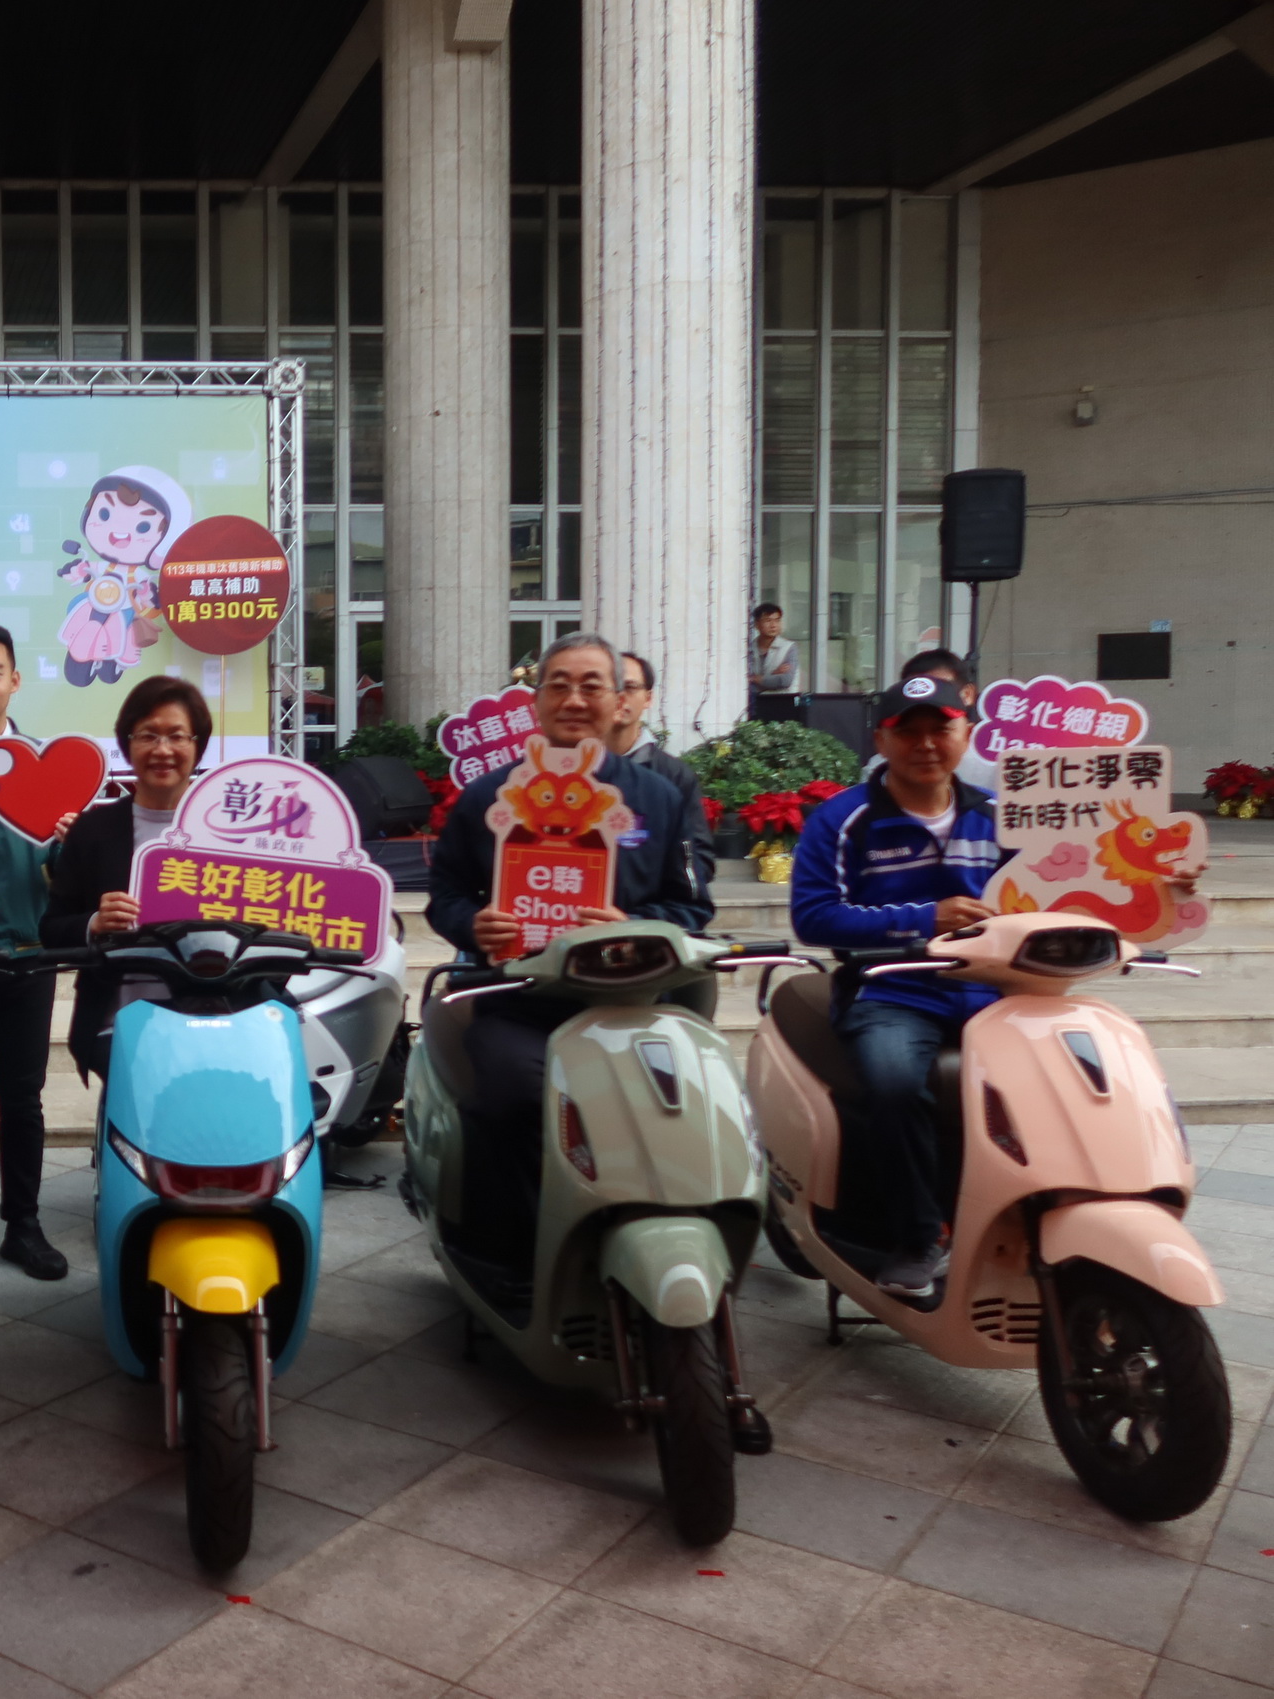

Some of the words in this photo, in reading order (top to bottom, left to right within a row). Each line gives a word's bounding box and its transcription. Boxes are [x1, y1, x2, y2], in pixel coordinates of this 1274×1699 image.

[165, 559, 284, 576] 113年機車汰舊換新補助
[189, 576, 260, 597] 最高補助
[166, 597, 279, 623] 1萬9300元
[451, 704, 542, 752] 汰車補
[994, 694, 1130, 741] 彰化鄉親
[1002, 750, 1164, 793] 彰化淨零
[1002, 801, 1103, 832] 新時代
[254, 836, 305, 854] 縣政府
[157, 857, 326, 910] 美好彰化
[527, 865, 585, 894] e騎
